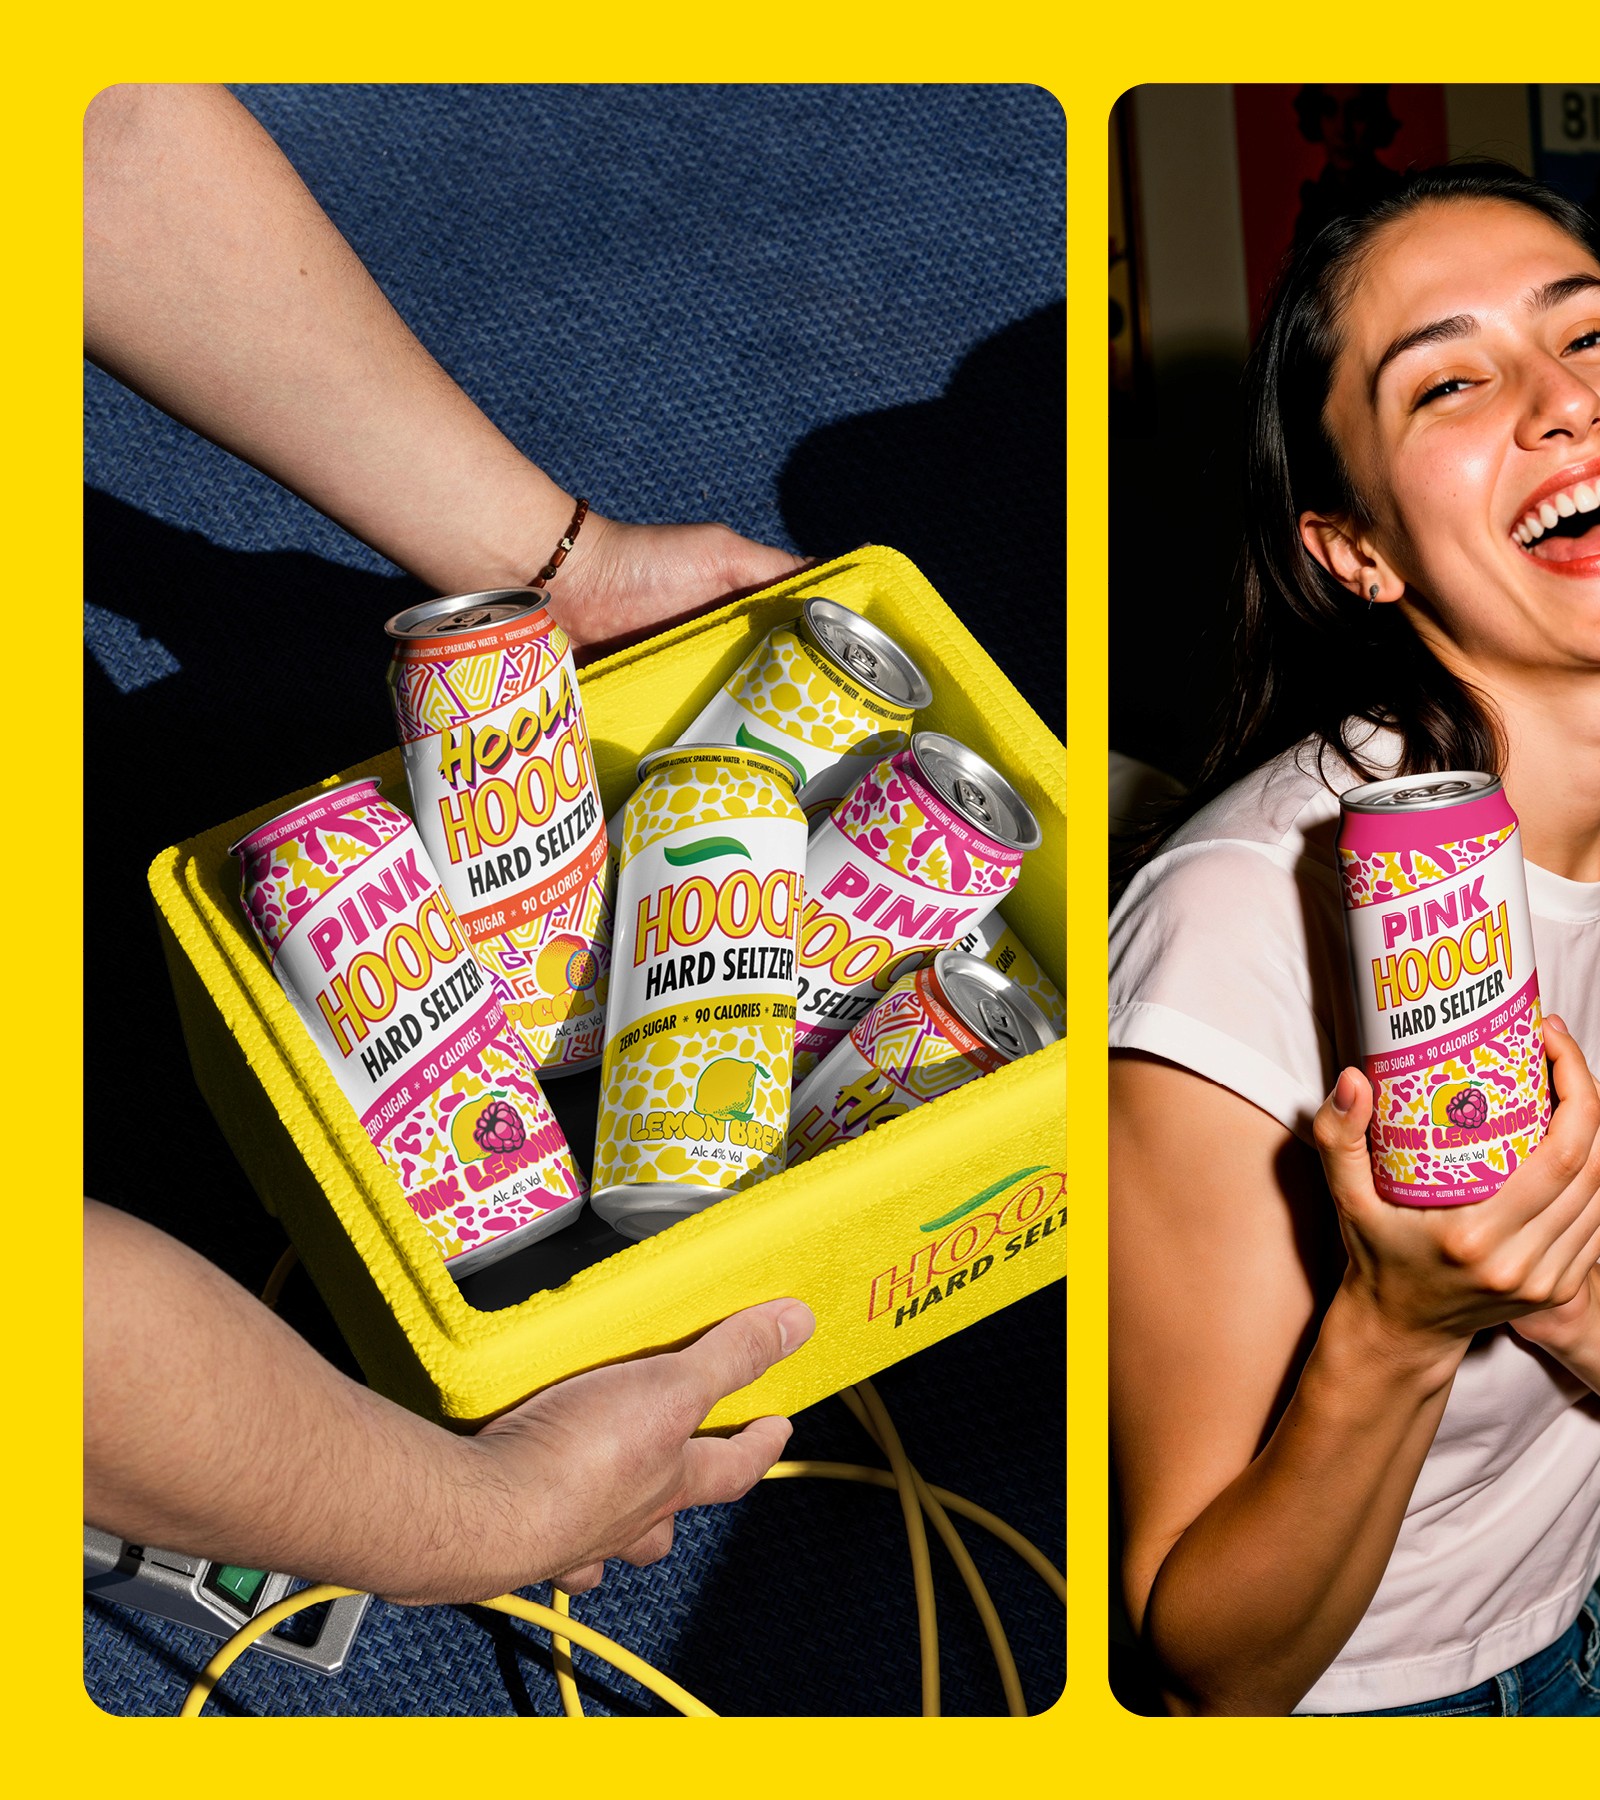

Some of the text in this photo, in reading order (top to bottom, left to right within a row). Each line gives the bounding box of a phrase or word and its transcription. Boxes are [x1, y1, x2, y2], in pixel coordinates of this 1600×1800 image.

[444, 642, 476, 655] SPARKLING
[478, 636, 498, 648] WATER
[505, 625, 534, 642] REFRESHINGLY
[818, 660, 842, 687] SPARKLING
[842, 681, 860, 700] WATER
[862, 698, 890, 718] REFRESHINGLY
[438, 666, 577, 790] HOOLA
[438, 706, 599, 864] HOOCH
[669, 756, 692, 766] ALCOHOLIC
[693, 755, 722, 763] SPARKLING
[723, 756, 740, 765] WATER
[747, 759, 774, 774] REFRESHINGLY
[279, 816, 307, 837] SPARKLING
[307, 807, 327, 823] WATER
[331, 795, 361, 811] REFRESHINGLY
[467, 846, 531, 897] HARD
[535, 791, 597, 867] SELTZER
[924, 797, 951, 826] SPARKLING
[949, 820, 969, 841] WATER
[972, 840, 1001, 859] REFRESHINGLY
[307, 848, 431, 973] PINK
[473, 911, 506, 935] SUGAR
[521, 896, 537, 915] 90
[539, 866, 583, 904] CALORIES
[633, 869, 805, 974] HOOCH
[821, 861, 979, 941] PINK
[1382, 874, 1489, 950] PINK
[316, 884, 483, 1059] HOOCH
[646, 951, 716, 1000] HARD
[722, 946, 794, 981] SELTZER
[996, 946, 1017, 974] CARBS
[1371, 900, 1513, 1011] HOOCH
[360, 958, 484, 1083] HARD SELTZER
[502, 990, 595, 1030] PICAL
[555, 1012, 603, 1038] Alc 4% Vol
[619, 1028, 640, 1054] ZERO
[642, 1014, 677, 1039] SUGAR
[695, 1008, 711, 1024] 90
[714, 1003, 761, 1021] CALORIES
[772, 1002, 788, 1018] ZERO
[804, 987, 881, 1020] SELTZ
[1374, 992, 1527, 1074] ZERO SUGAR 90 CALORIES ZERO CARBS
[1390, 969, 1505, 1040] HARD SELTZER
[793, 1030, 827, 1048] ORIES
[944, 1019, 972, 1048] SPARKLING
[970, 1044, 988, 1061] WATER
[366, 1114, 383, 1140] ZERO
[382, 1087, 412, 1123] SUGAR
[422, 1066, 440, 1084] 90
[439, 1029, 481, 1070] CALORIES
[630, 1111, 727, 1143] LEMON
[729, 1117, 784, 1160] BREW
[690, 1145, 743, 1163] Alc 4% Vol
[1382, 1100, 1538, 1150] PINK LEMONADE
[464, 1120, 568, 1192] LEMONAD
[1444, 1149, 1485, 1164] Alc 4% Vol
[493, 1172, 542, 1206] Alc 4% Vol
[1392, 1186, 1489, 1198] NATURAL FLAVOURS GLUTEN FREE VEGAN
[867, 1171, 1067, 1322] HOO
[894, 1206, 1067, 1329] HARD SELT
